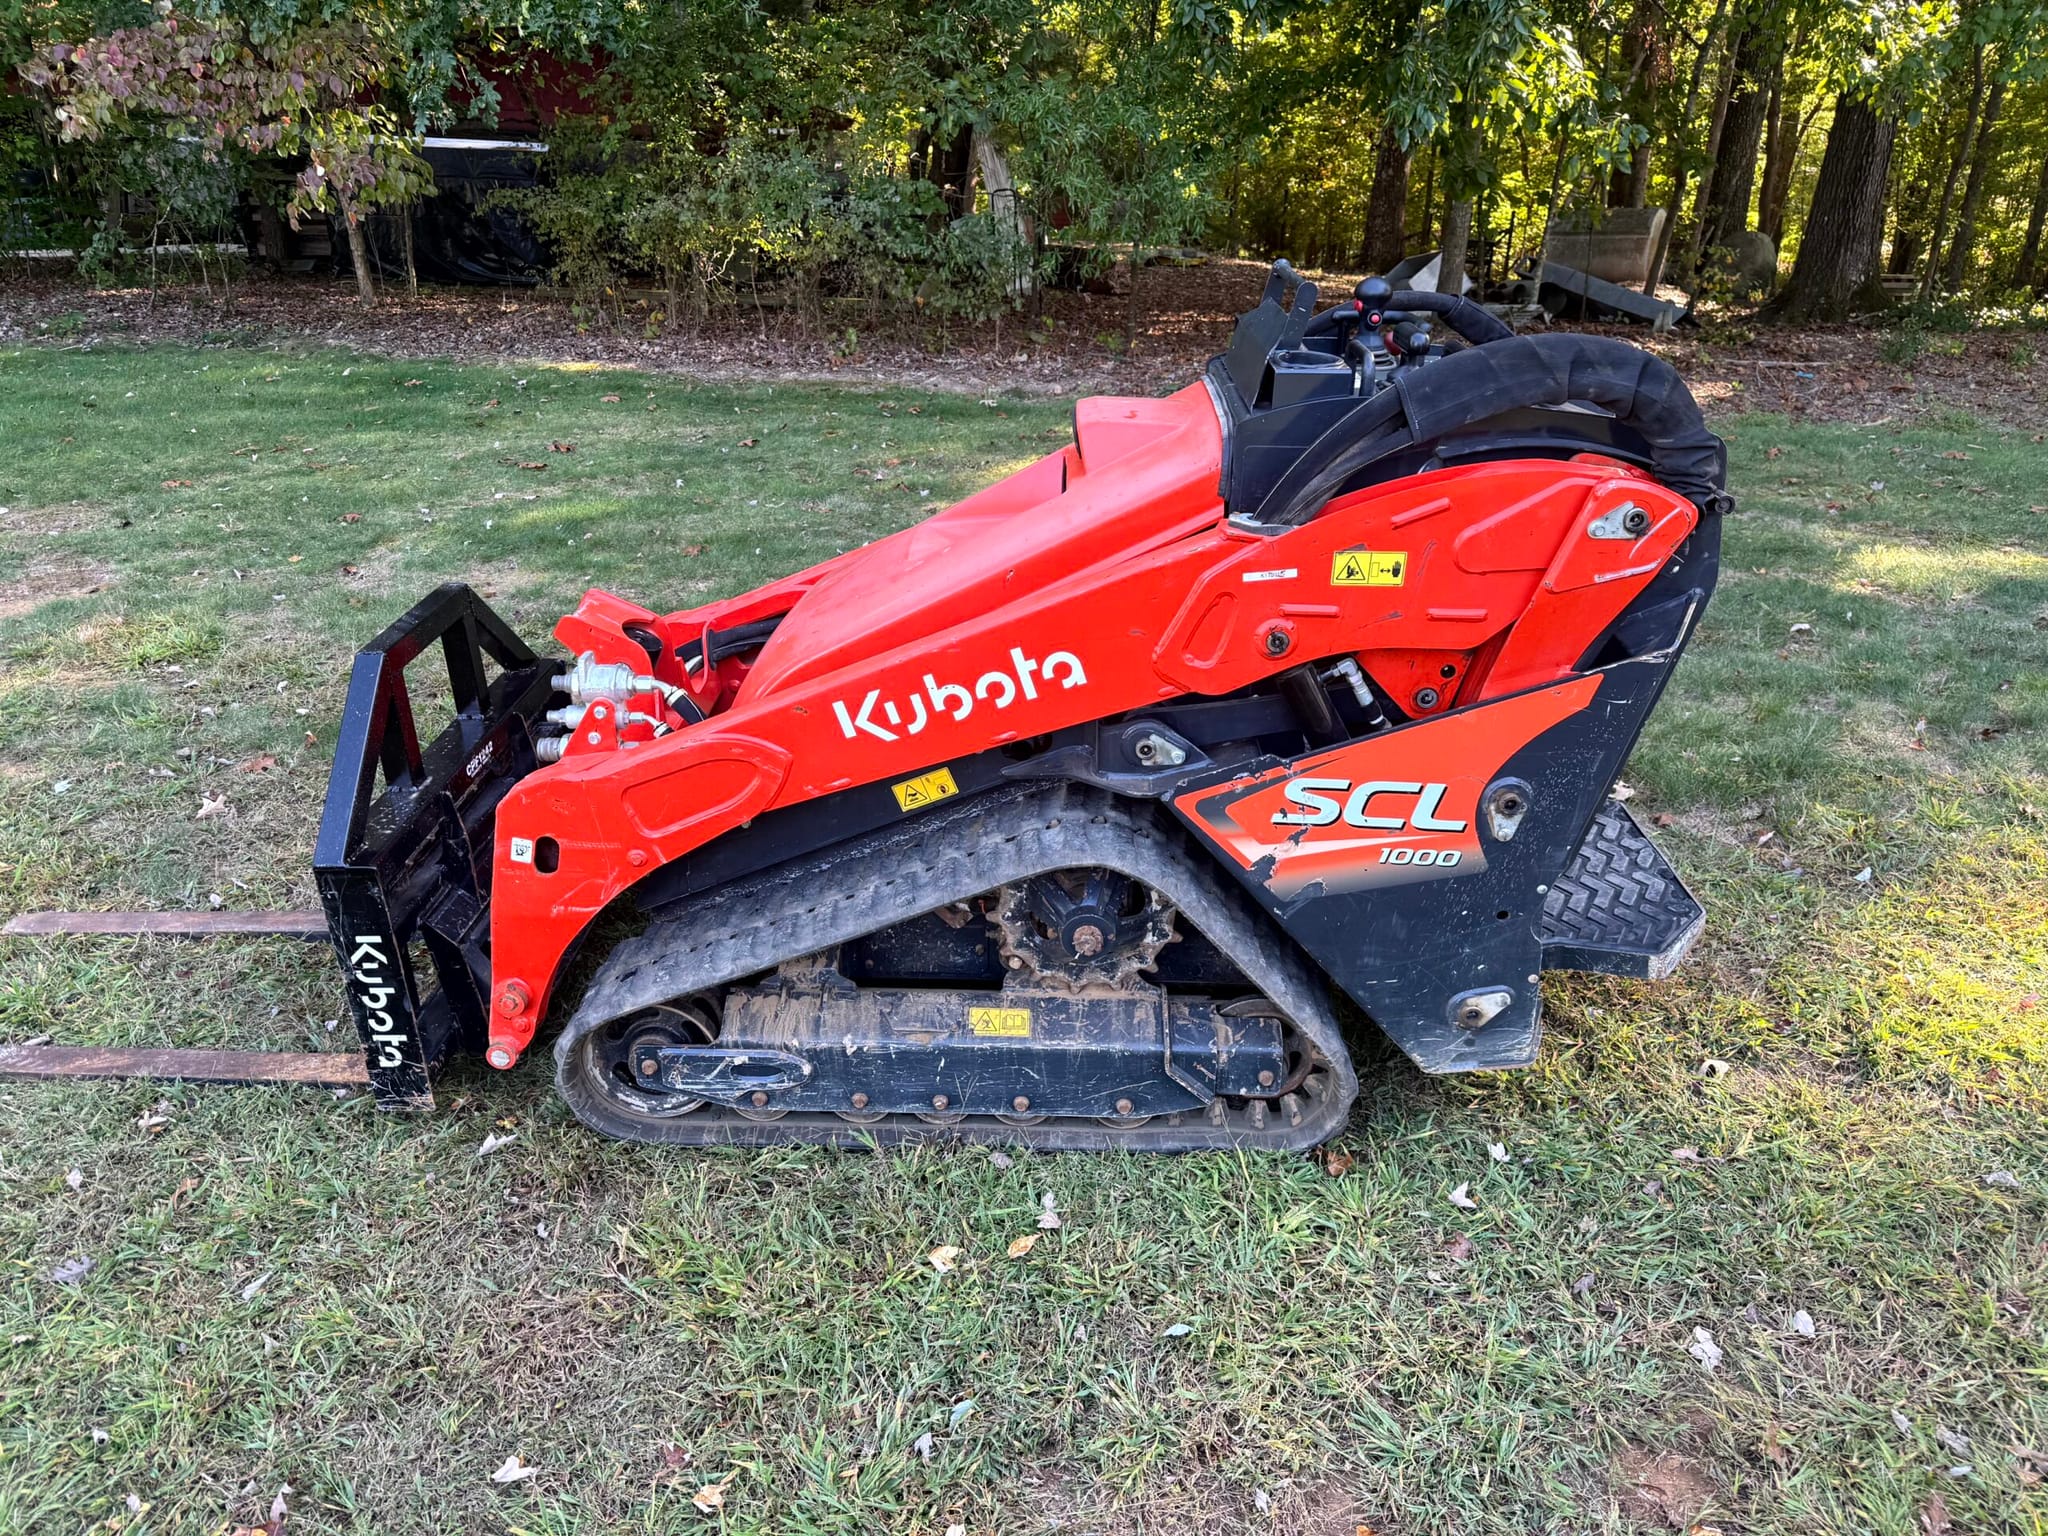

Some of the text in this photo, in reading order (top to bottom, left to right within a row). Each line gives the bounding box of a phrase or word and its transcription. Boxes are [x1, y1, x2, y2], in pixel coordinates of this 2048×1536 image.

[832, 647, 1087, 741] Kubota
[1271, 777, 1468, 834] SCL
[1379, 847, 1464, 867] 1000
[351, 935, 407, 1068] Kubota
